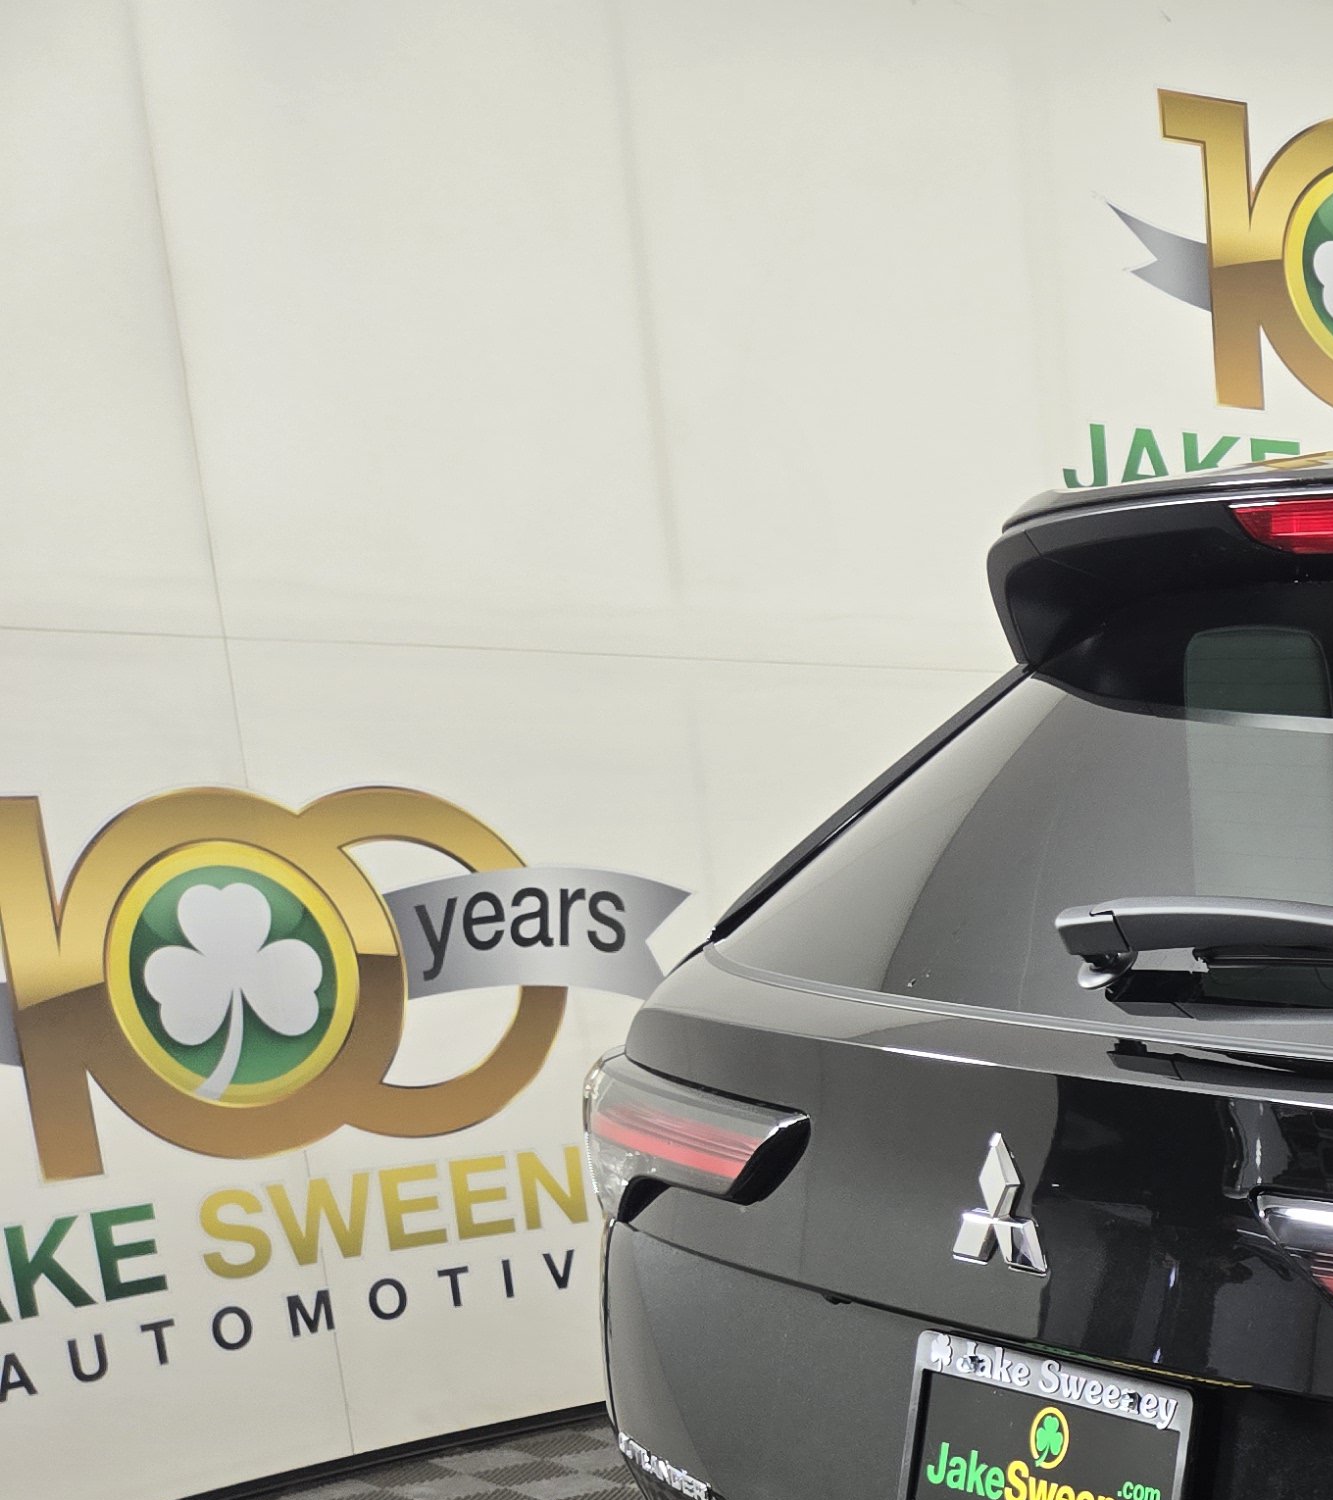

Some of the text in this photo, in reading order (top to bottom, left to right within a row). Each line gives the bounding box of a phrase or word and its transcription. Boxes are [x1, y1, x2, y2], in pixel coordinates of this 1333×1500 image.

[0, 785, 568, 1183] 100
[414, 886, 627, 981] years
[0, 1145, 589, 1324] KE SWEEN
[0, 1249, 575, 1402] AUTOMOTIV
[956, 1341, 1179, 1430] Jake Sweeney
